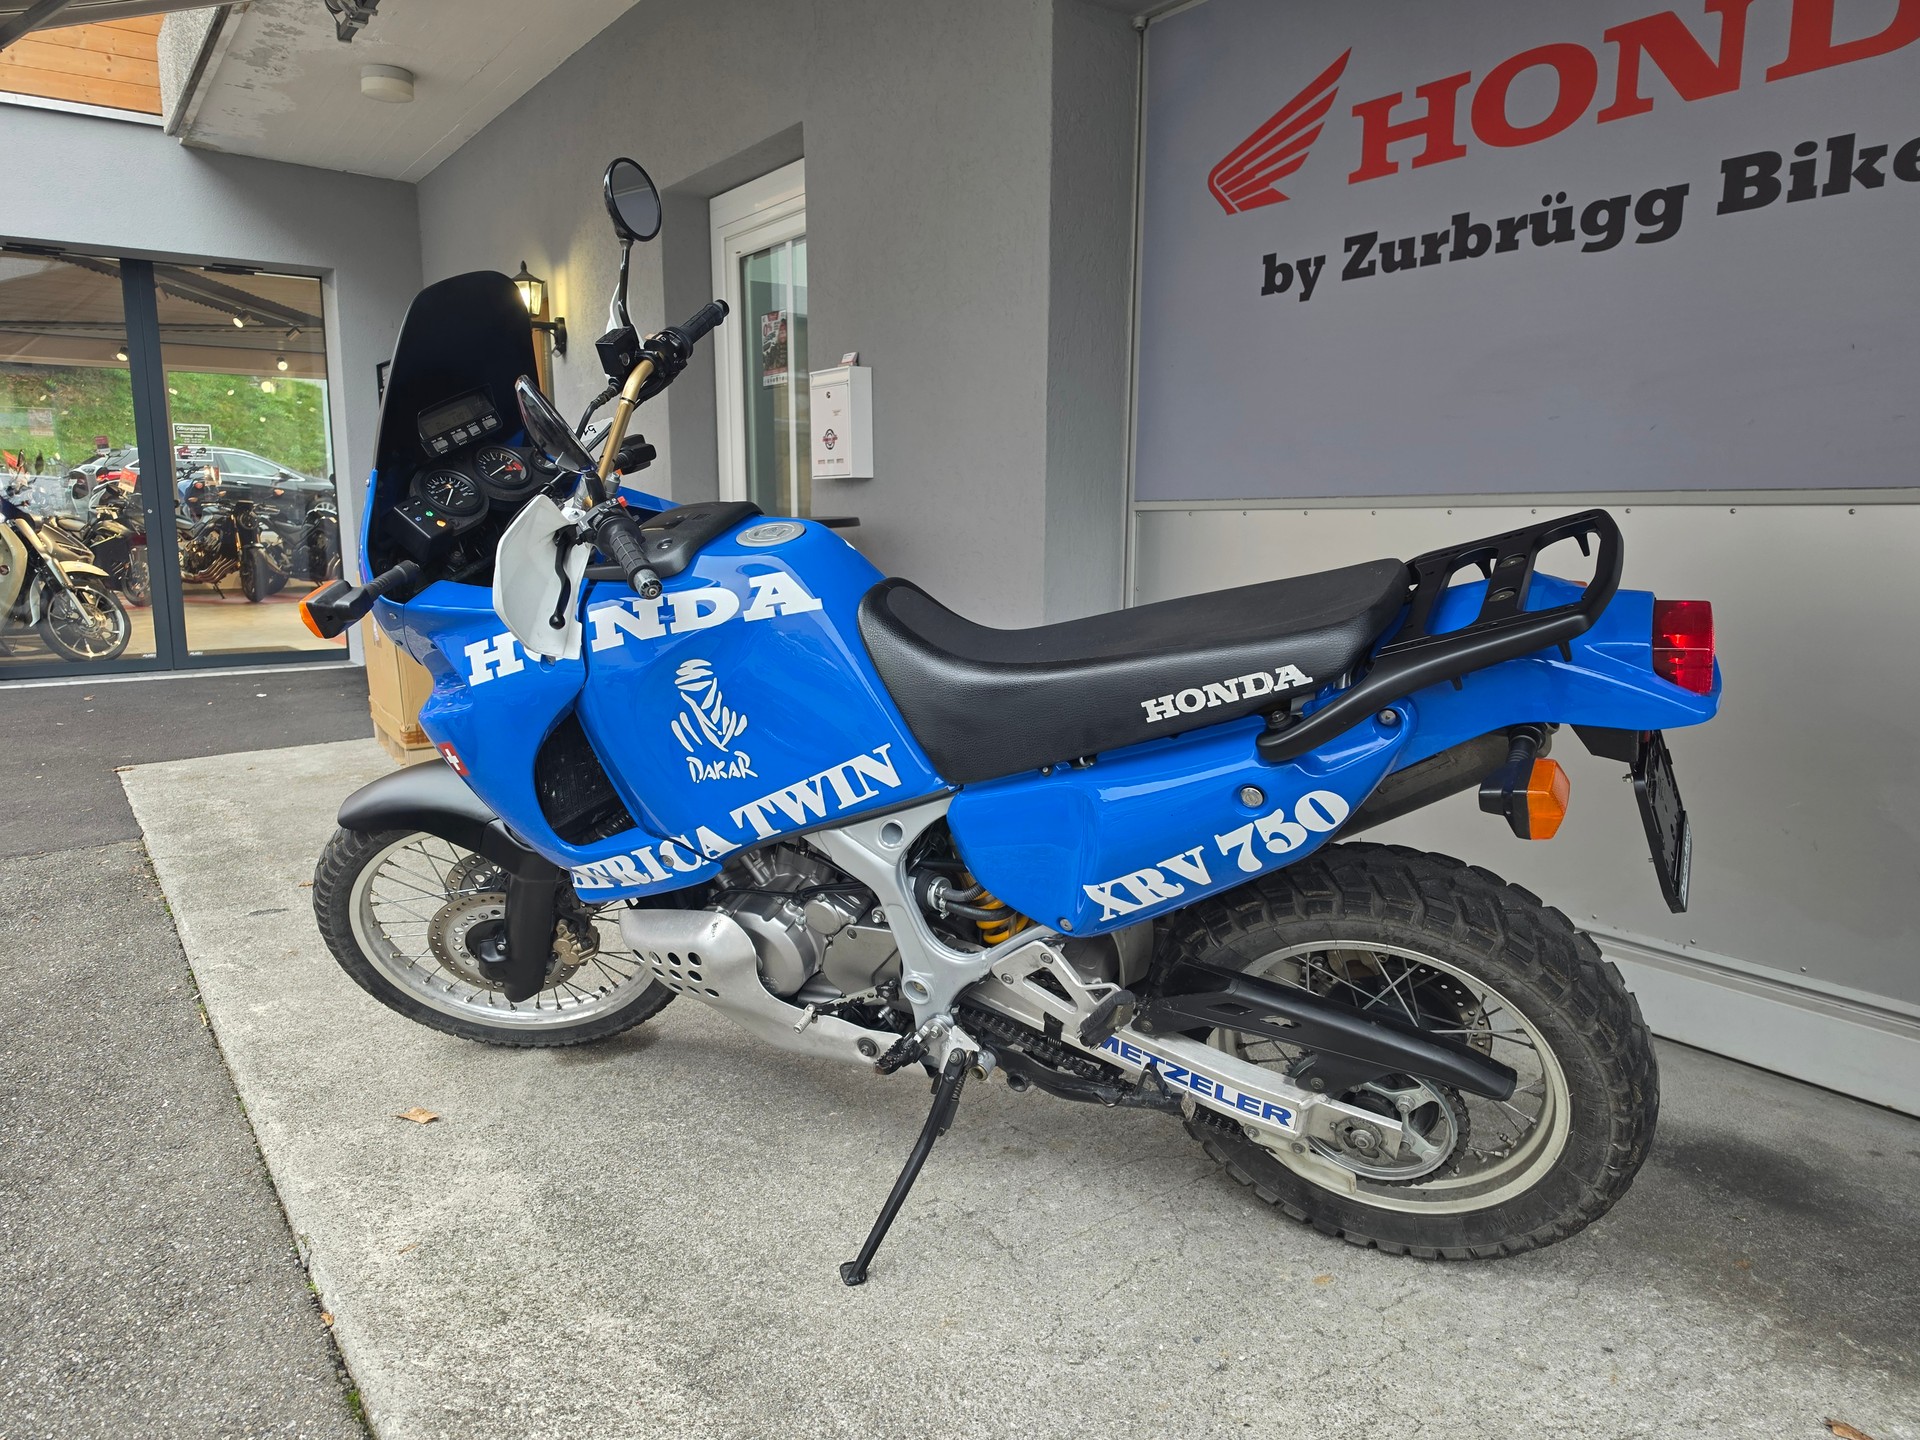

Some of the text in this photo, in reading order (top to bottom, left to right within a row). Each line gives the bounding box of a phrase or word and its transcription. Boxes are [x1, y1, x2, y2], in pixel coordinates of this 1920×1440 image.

[1260, 253, 1326, 303] by
[1341, 182, 1691, 283] Zurbrügg
[463, 571, 823, 688] HNDA
[1140, 663, 1314, 724] HONDA
[685, 750, 759, 784] DAKAR
[729, 742, 902, 841] TWIN
[1082, 789, 1351, 922] XRV 750
